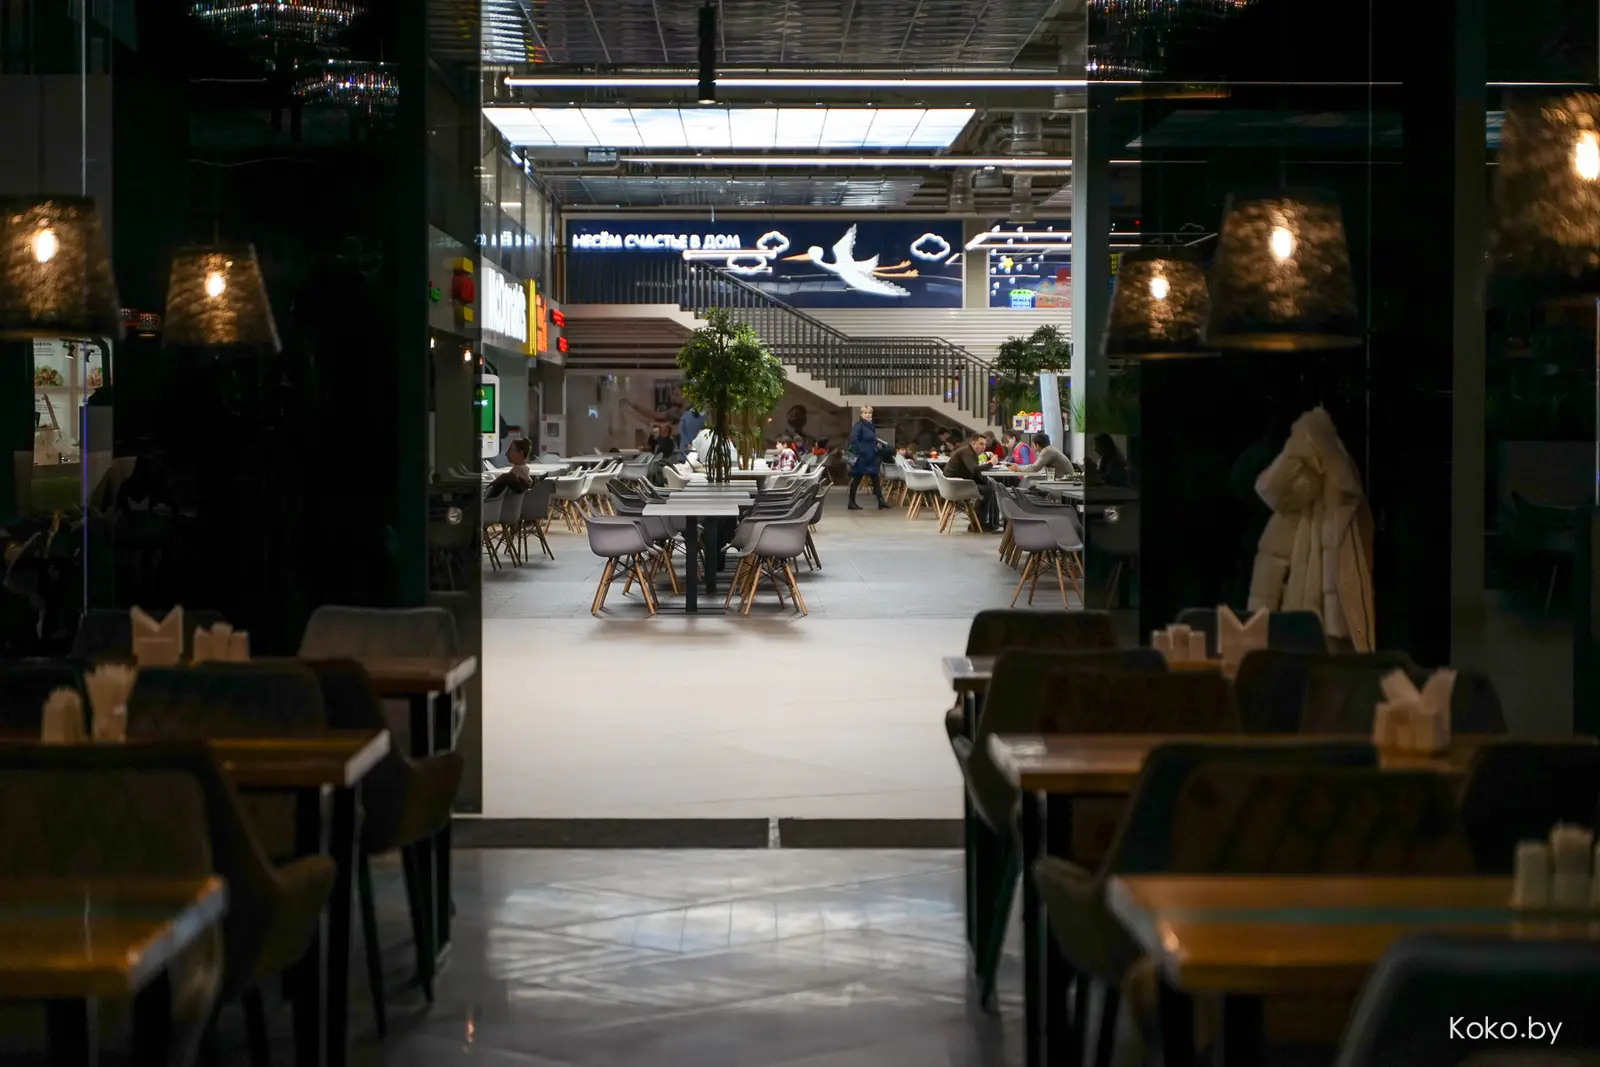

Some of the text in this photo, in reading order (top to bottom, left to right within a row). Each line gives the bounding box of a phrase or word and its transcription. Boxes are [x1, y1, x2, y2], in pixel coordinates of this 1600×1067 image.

[572, 231, 741, 249] НЕСЁМ СЧАСТЬЕ В ДОМ
